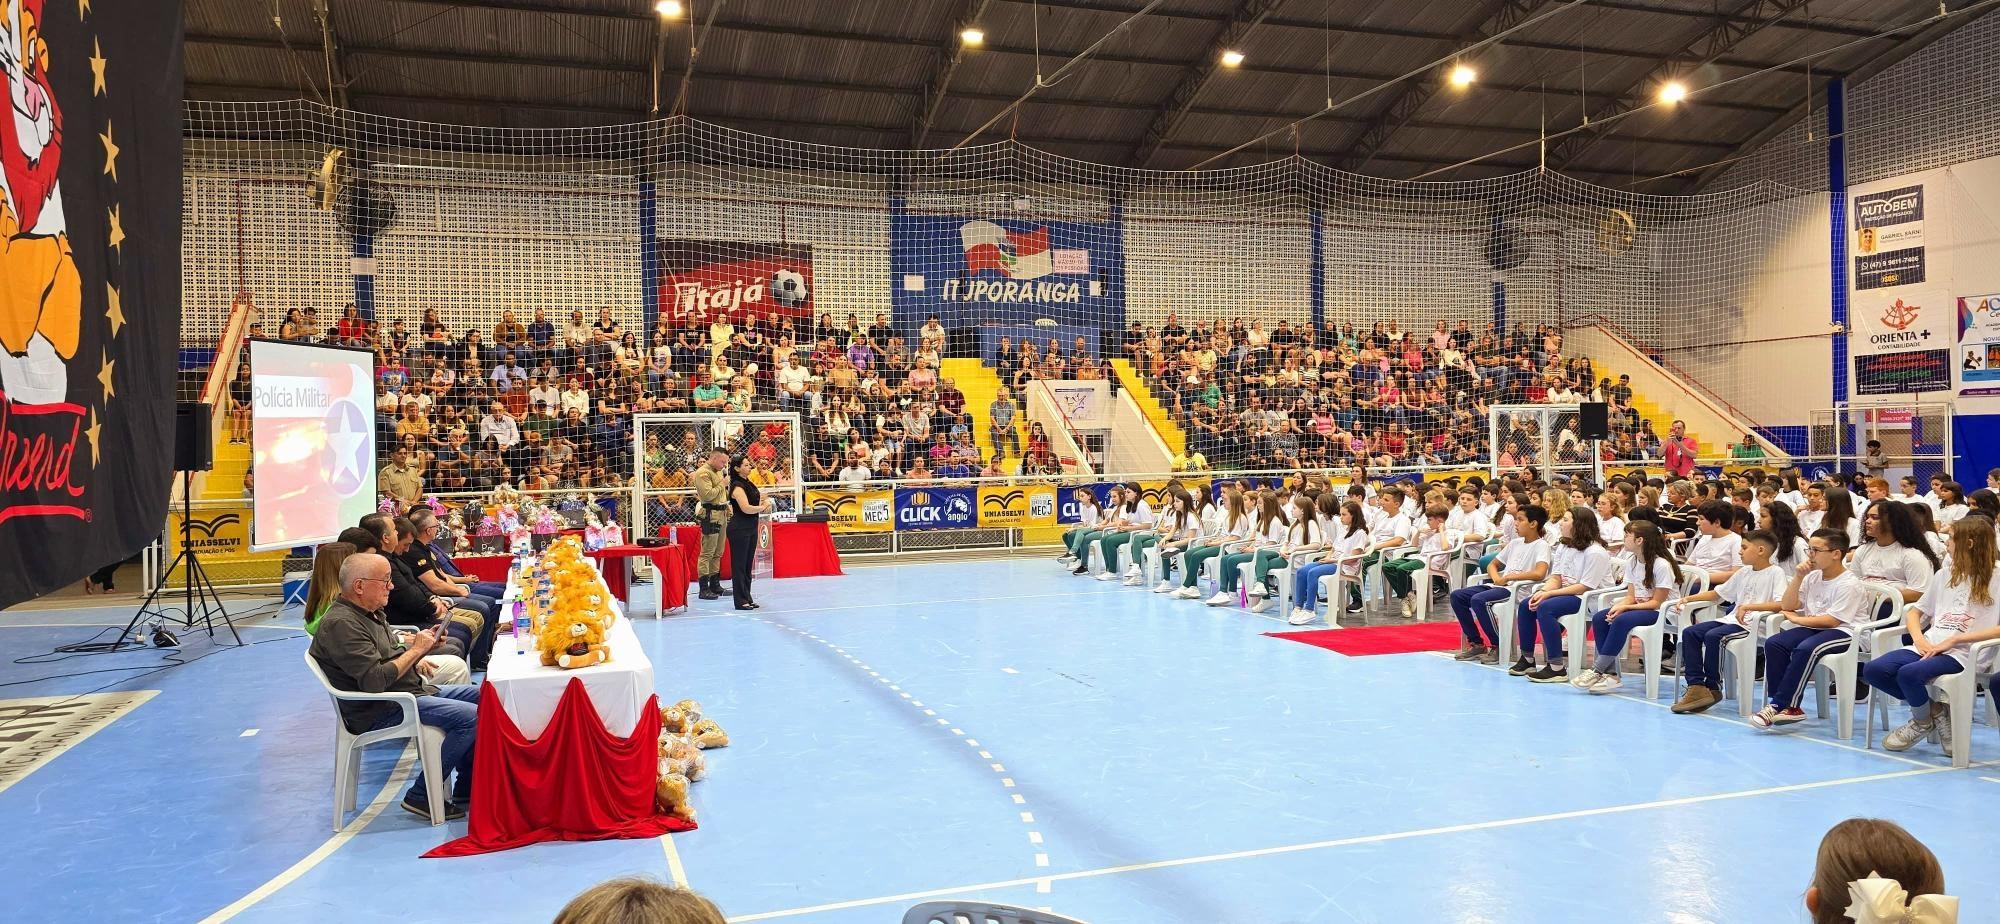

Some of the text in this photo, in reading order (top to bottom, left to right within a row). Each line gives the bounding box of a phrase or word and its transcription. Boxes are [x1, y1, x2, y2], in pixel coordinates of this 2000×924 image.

[1861, 197, 1919, 217] AUTOBEM
[1870, 331, 1918, 344] ORIENTA
[254, 385, 332, 408] Polícia Militar
[865, 511, 883, 522] MEC
[883, 504, 889, 521] 5
[900, 506, 941, 523] CLICK
[984, 509, 1025, 518] UNIASSELVI
[1031, 499, 1053, 516] MEC 5
[947, 512, 968, 523] anglo
[61, 700, 134, 730] VISUAL
